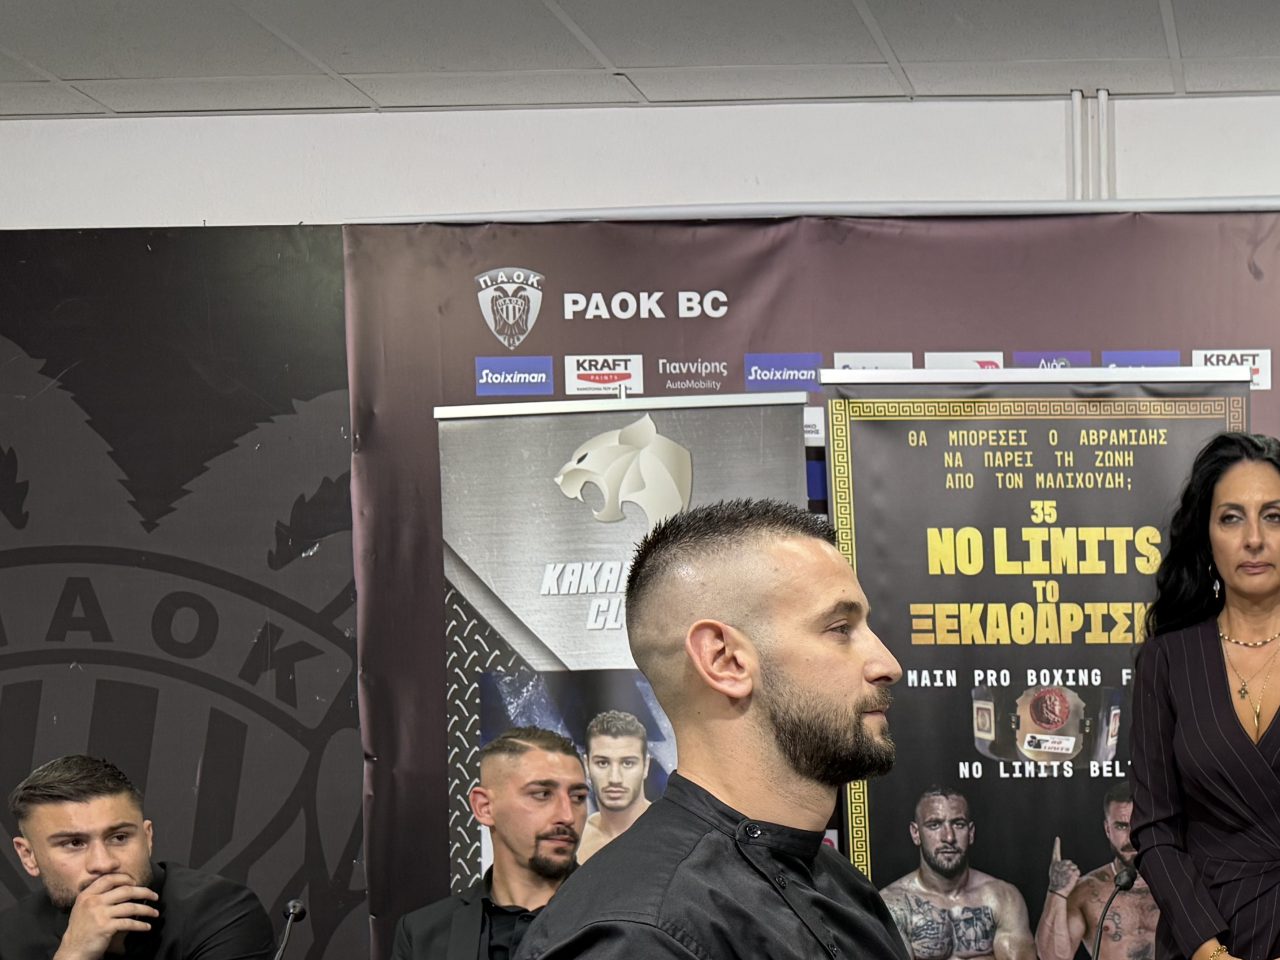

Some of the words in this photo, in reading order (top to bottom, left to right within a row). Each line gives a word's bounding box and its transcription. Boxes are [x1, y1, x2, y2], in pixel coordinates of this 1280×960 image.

[563, 291, 666, 320] PAOK
[678, 290, 728, 318] BC
[576, 359, 632, 371] KRAFT
[658, 358, 728, 376] Γιαννίρης
[1204, 353, 1260, 366] KRAFT
[479, 369, 547, 384] Stoiximan
[748, 365, 817, 381] Stoiximan
[665, 379, 722, 391] AutoMobility
[908, 430, 927, 446] ΘΑ
[948, 430, 1028, 446] ΜΠΟΡΕΣΕΙ
[1079, 429, 1168, 446] ΑΒΡΑΜΙΔΗΣ
[944, 451, 963, 468] ΝΑ
[984, 451, 1033, 468] ΠΑΡΕΙ
[1055, 451, 1074, 467] ΤΗ
[1095, 451, 1134, 467] ΖΩΝΗ
[945, 473, 974, 489] ΑΠΟ
[995, 473, 1023, 489] ΤΟΝ
[1036, 473, 1132, 490] ΜΑΛΙΧΟΥΔΗ;
[1030, 500, 1057, 523] 35
[926, 526, 984, 575] NO
[993, 526, 1162, 575] LIMITS
[1032, 580, 1060, 602] ΤΟ
[0, 576, 325, 709] ΑΟΚ
[907, 669, 957, 687] MAIN
[974, 669, 1011, 687] PRO
[1027, 669, 1102, 686] BOXING
[958, 761, 983, 778] NO
[1000, 761, 1074, 778] LIMITS
[1089, 760, 1132, 777] BEL
